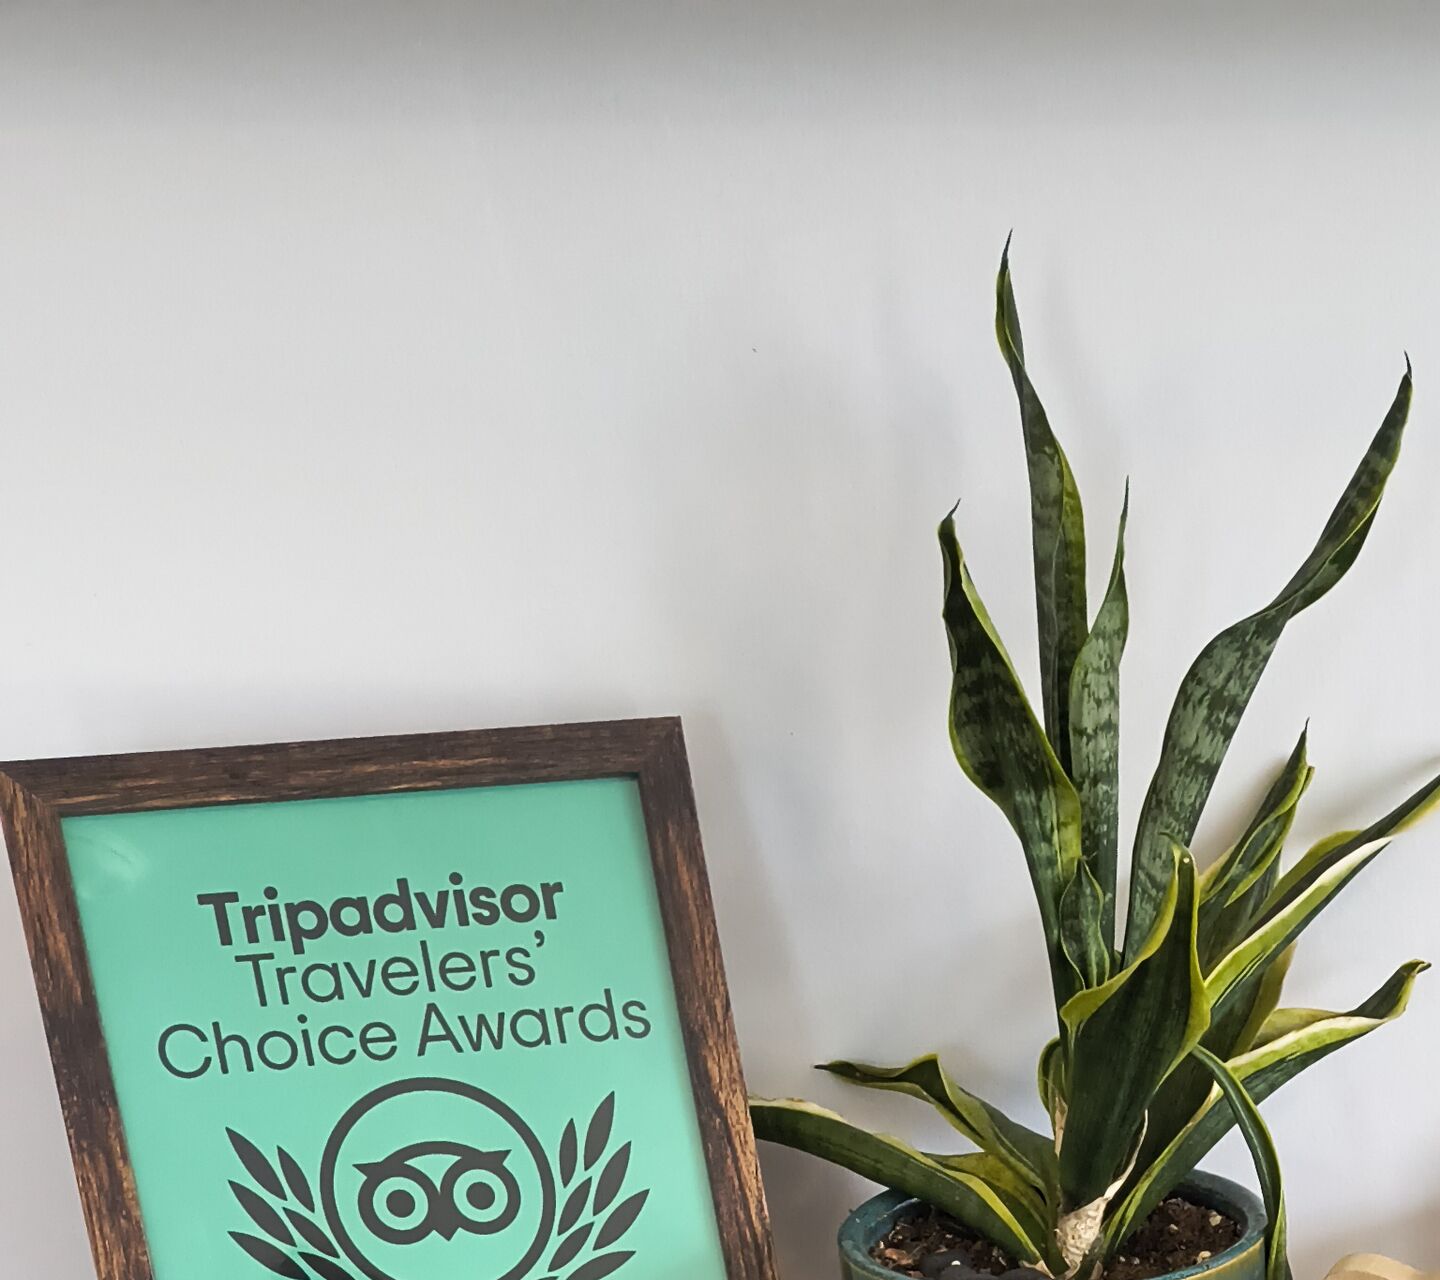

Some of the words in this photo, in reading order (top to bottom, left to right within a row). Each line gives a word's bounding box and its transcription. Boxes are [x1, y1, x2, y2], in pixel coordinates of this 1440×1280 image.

[196, 870, 564, 954] Tripadvisor
[234, 928, 547, 1008] Travelers’
[157, 1012, 399, 1080] Choice
[416, 987, 653, 1057] Awards
